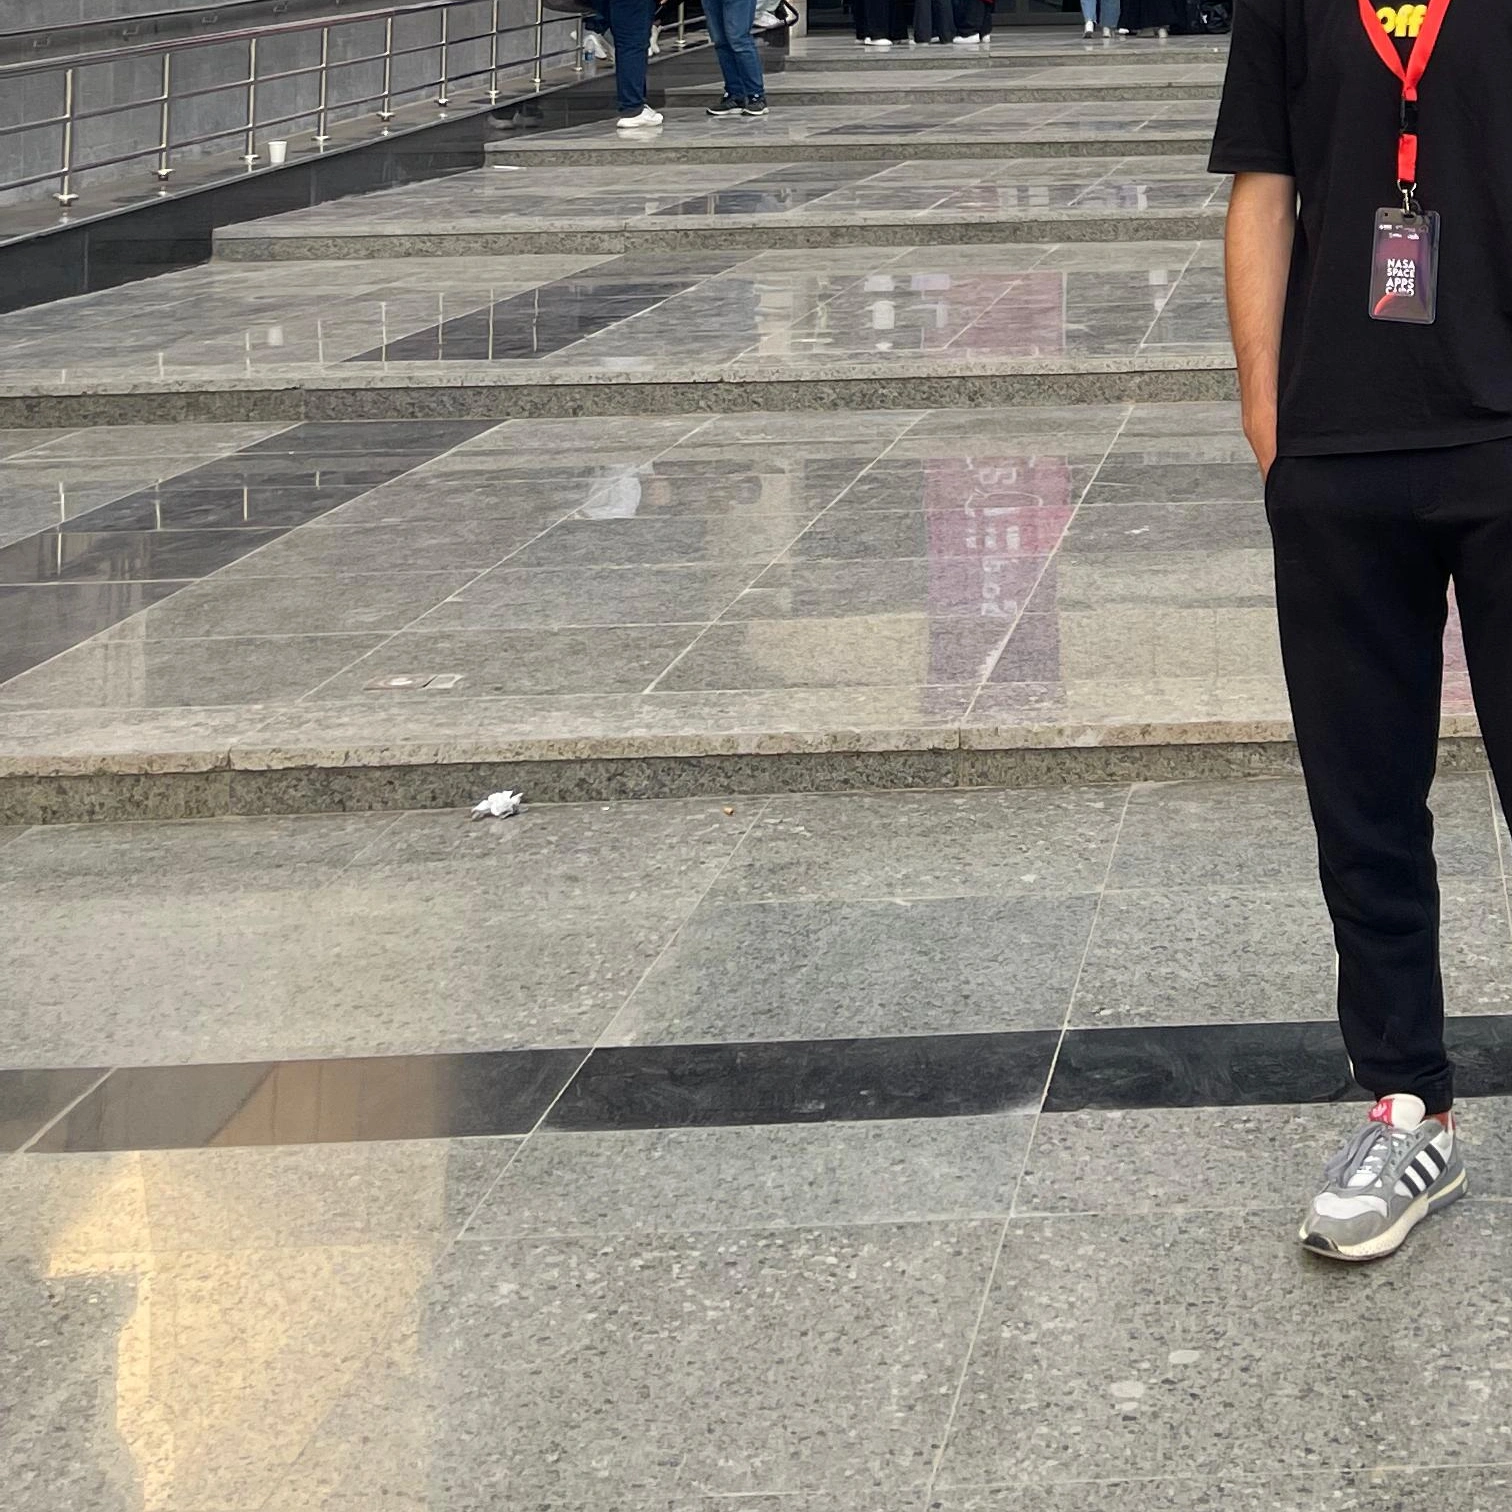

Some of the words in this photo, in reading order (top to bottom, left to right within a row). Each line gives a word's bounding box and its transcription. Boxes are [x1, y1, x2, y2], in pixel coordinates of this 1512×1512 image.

[1375, 4, 1428, 38] off
[1387, 258, 1415, 269] NASA
[1386, 267, 1415, 278] SPACE
[1385, 276, 1415, 289] APPS
